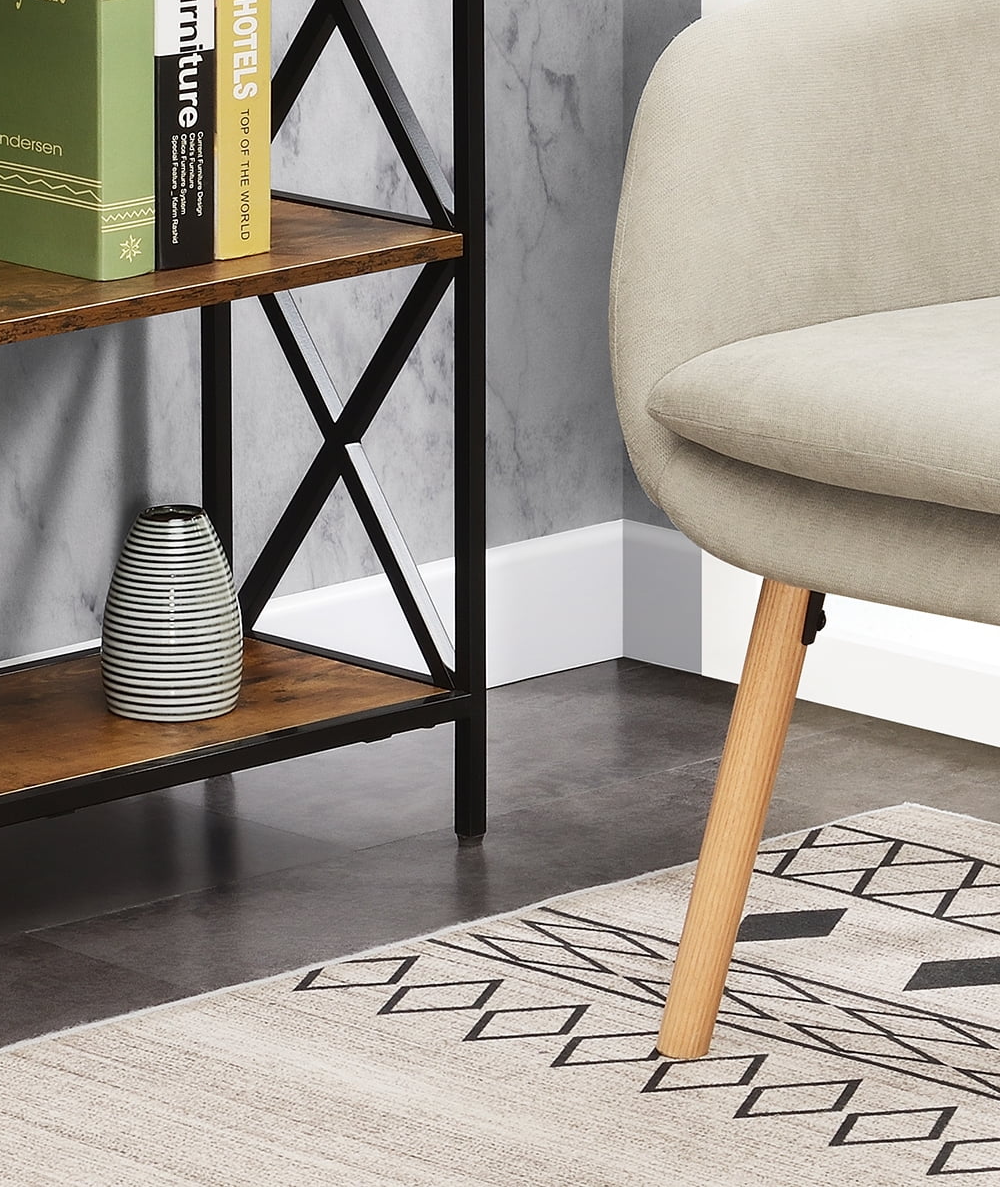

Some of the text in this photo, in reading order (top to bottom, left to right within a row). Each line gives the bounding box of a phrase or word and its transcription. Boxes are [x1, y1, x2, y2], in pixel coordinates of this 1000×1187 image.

[171, 134, 179, 162] Special
[179, 133, 188, 216] Office Furniture System
[240, 108, 250, 240] TOP OF THE WORLD
[196, 191, 204, 217] Design
